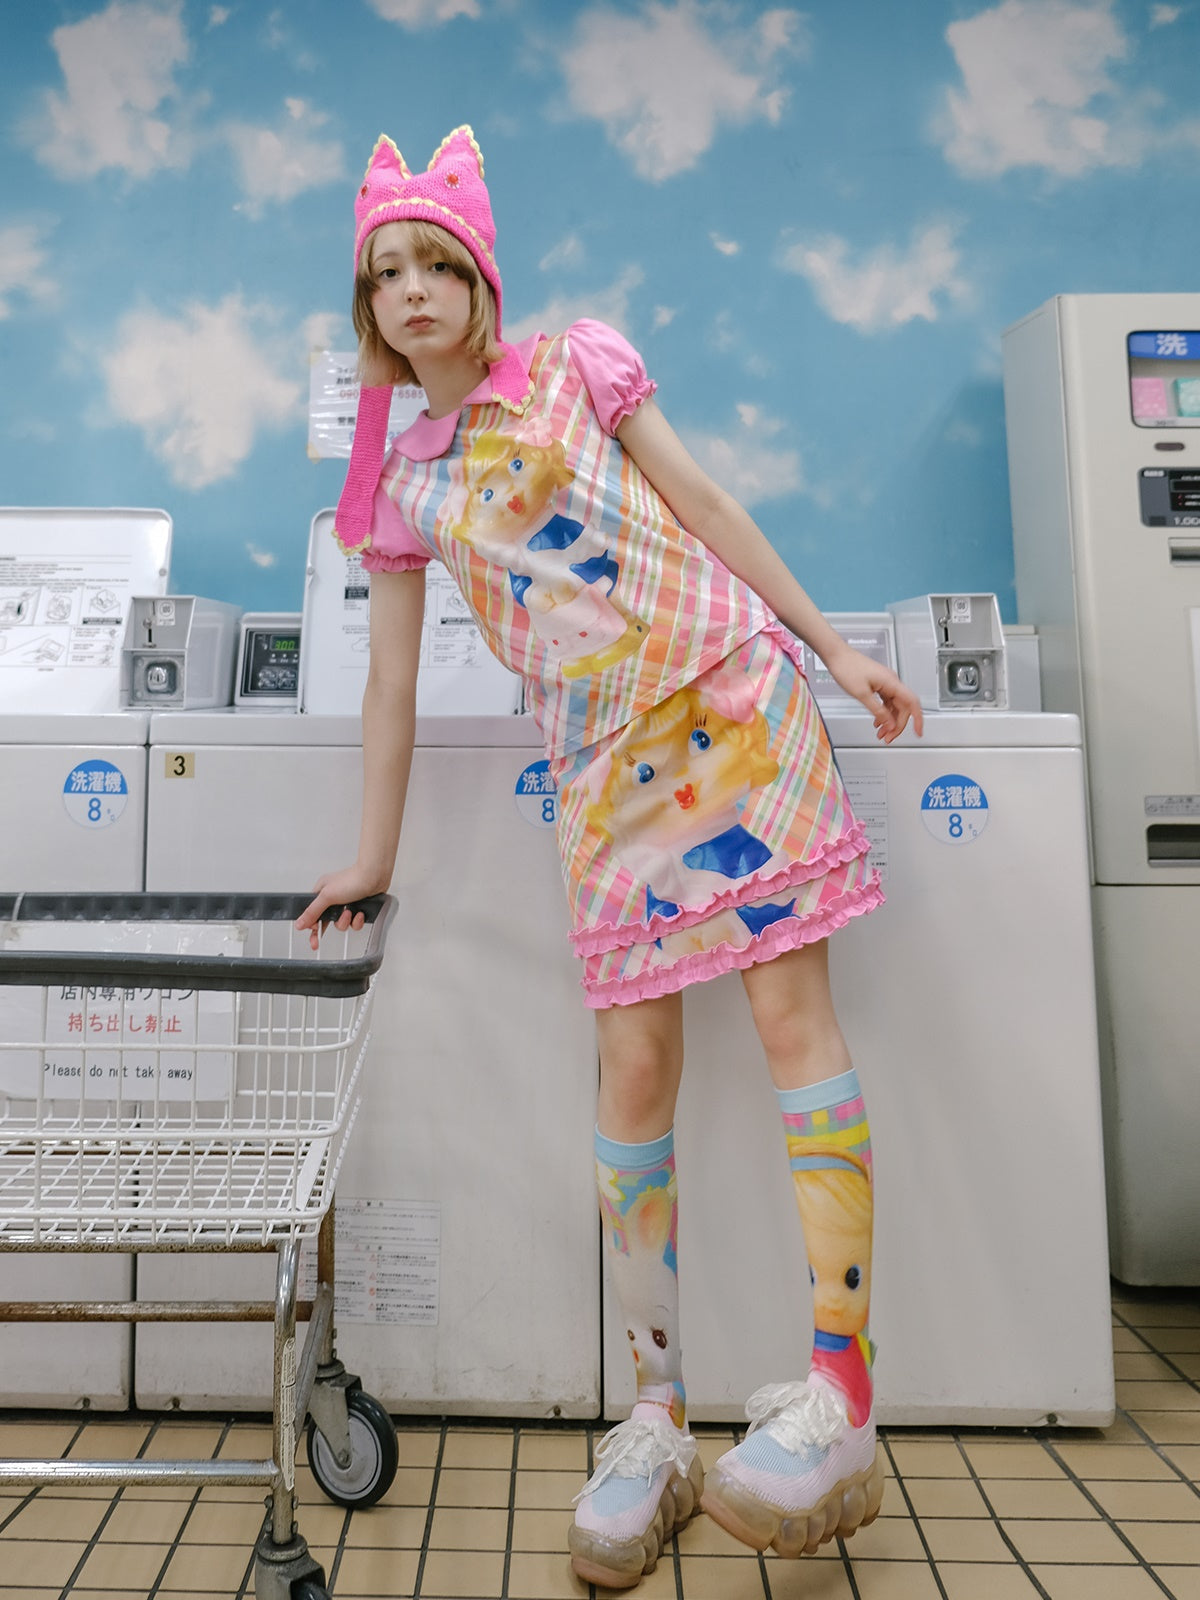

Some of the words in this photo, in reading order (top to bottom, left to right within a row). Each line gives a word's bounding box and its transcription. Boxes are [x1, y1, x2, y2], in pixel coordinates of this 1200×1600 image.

[1156, 333, 1188, 356] 洗
[173, 755, 186, 776] 3
[71, 770, 122, 793] 洗濯機
[522, 771, 556, 793] 洗濯
[928, 785, 981, 808] 洗濯機
[87, 797, 102, 822] 8
[542, 798, 555, 823] 8
[948, 813, 963, 838] 8
[68, 1012, 182, 1033] 持ち出し禁止
[44, 1063, 81, 1077] Please
[89, 1064, 103, 1078] do
[136, 1066, 161, 1078] tak
[167, 1067, 193, 1081] away
